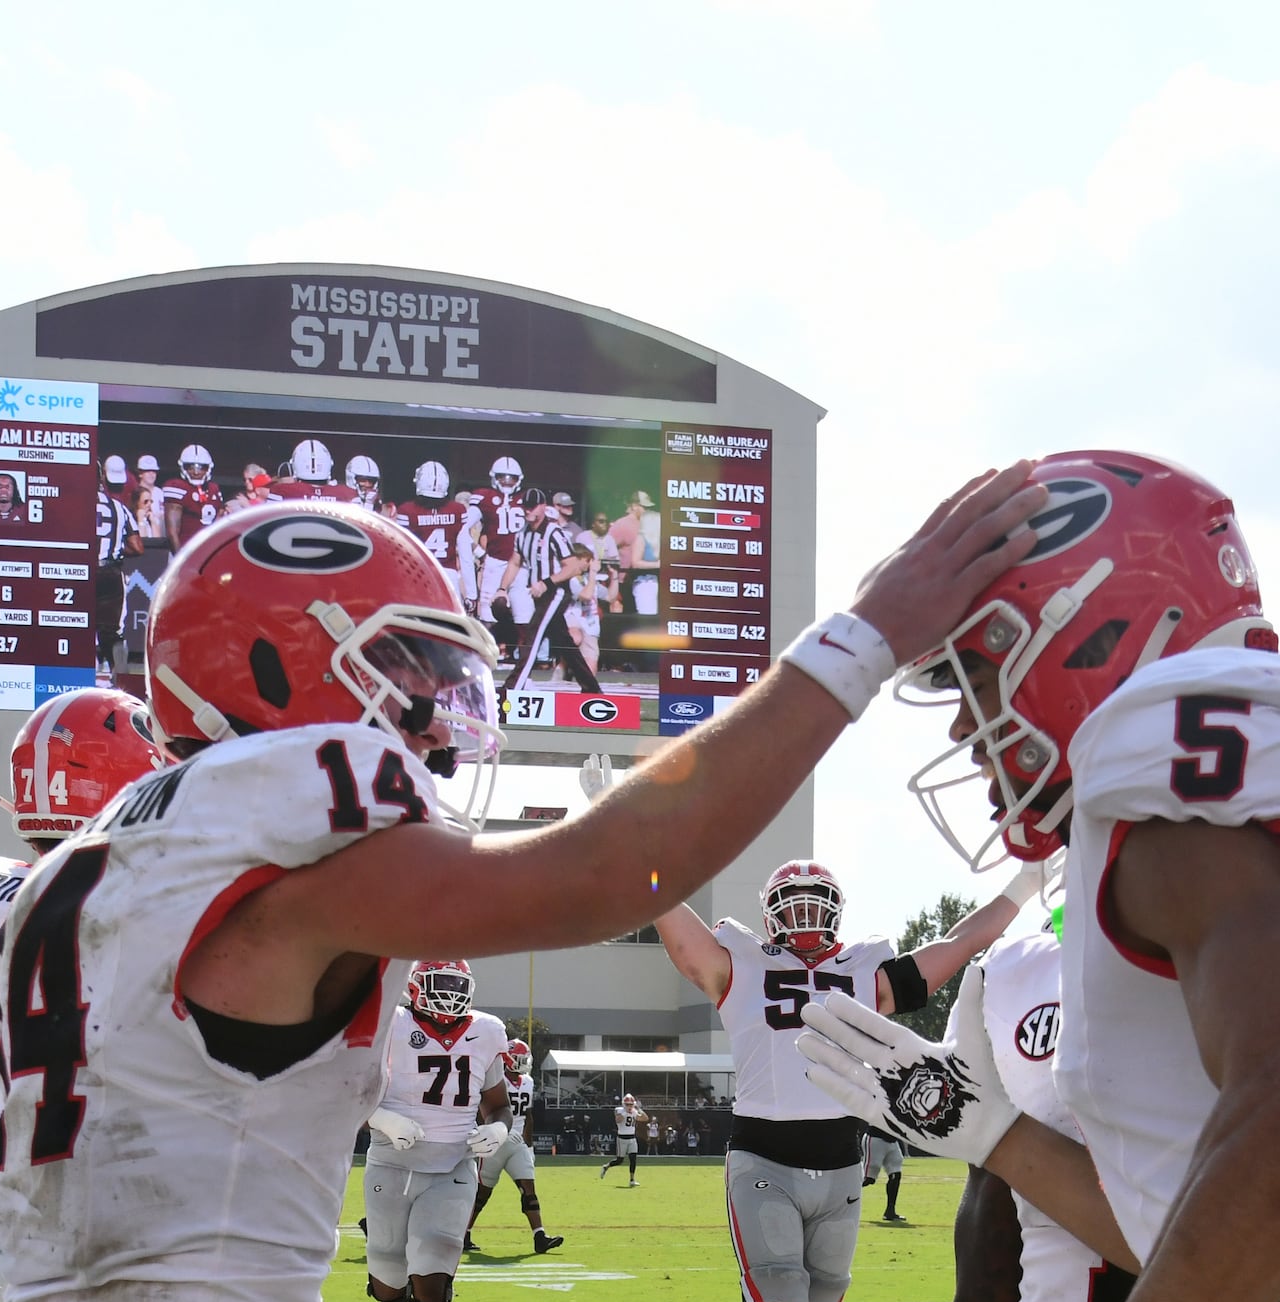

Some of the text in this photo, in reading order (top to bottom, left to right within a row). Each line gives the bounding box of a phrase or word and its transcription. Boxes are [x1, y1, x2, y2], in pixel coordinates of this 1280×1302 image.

[291, 283, 480, 324] MISSISSIPPI
[291, 315, 480, 379] STATE
[39, 394, 84, 410] spire
[26, 430, 90, 449] LEADERS
[696, 434, 768, 448] FARM BUREAU
[18, 450, 54, 460] RUSHING
[702, 447, 762, 460] INSURANCE
[28, 485, 59, 497] BOOTH
[667, 480, 764, 503] GAME STATS
[28, 500, 43, 523] 6
[496, 507, 525, 535] 16
[238, 514, 373, 574] G
[425, 528, 448, 558] 4
[670, 536, 687, 551] 83
[715, 542, 736, 550] YARDS
[745, 541, 762, 555] 181
[41, 567, 86, 577] TOTAL YARDS
[1, 586, 12, 602] 6
[54, 588, 74, 604] 22
[669, 579, 764, 598] 86 PASS YARDS 251
[4, 613, 28, 622] YARDS
[41, 615, 86, 624] TOUCHDOWNS
[694, 625, 713, 633] TOTAL
[715, 627, 736, 635] YARDS
[740, 625, 766, 640] 432
[58, 639, 69, 655] 0
[671, 664, 684, 679] 10
[708, 670, 730, 678] DOWNS
[517, 698, 544, 718] 37
[580, 698, 618, 723] G
[674, 703, 697, 715] Ford
[1170, 695, 1252, 803] 5
[316, 739, 429, 833] 14
[18, 819, 84, 831] GEORGIA
[418, 1055, 471, 1106] 71
[509, 1092, 530, 1116] 52
